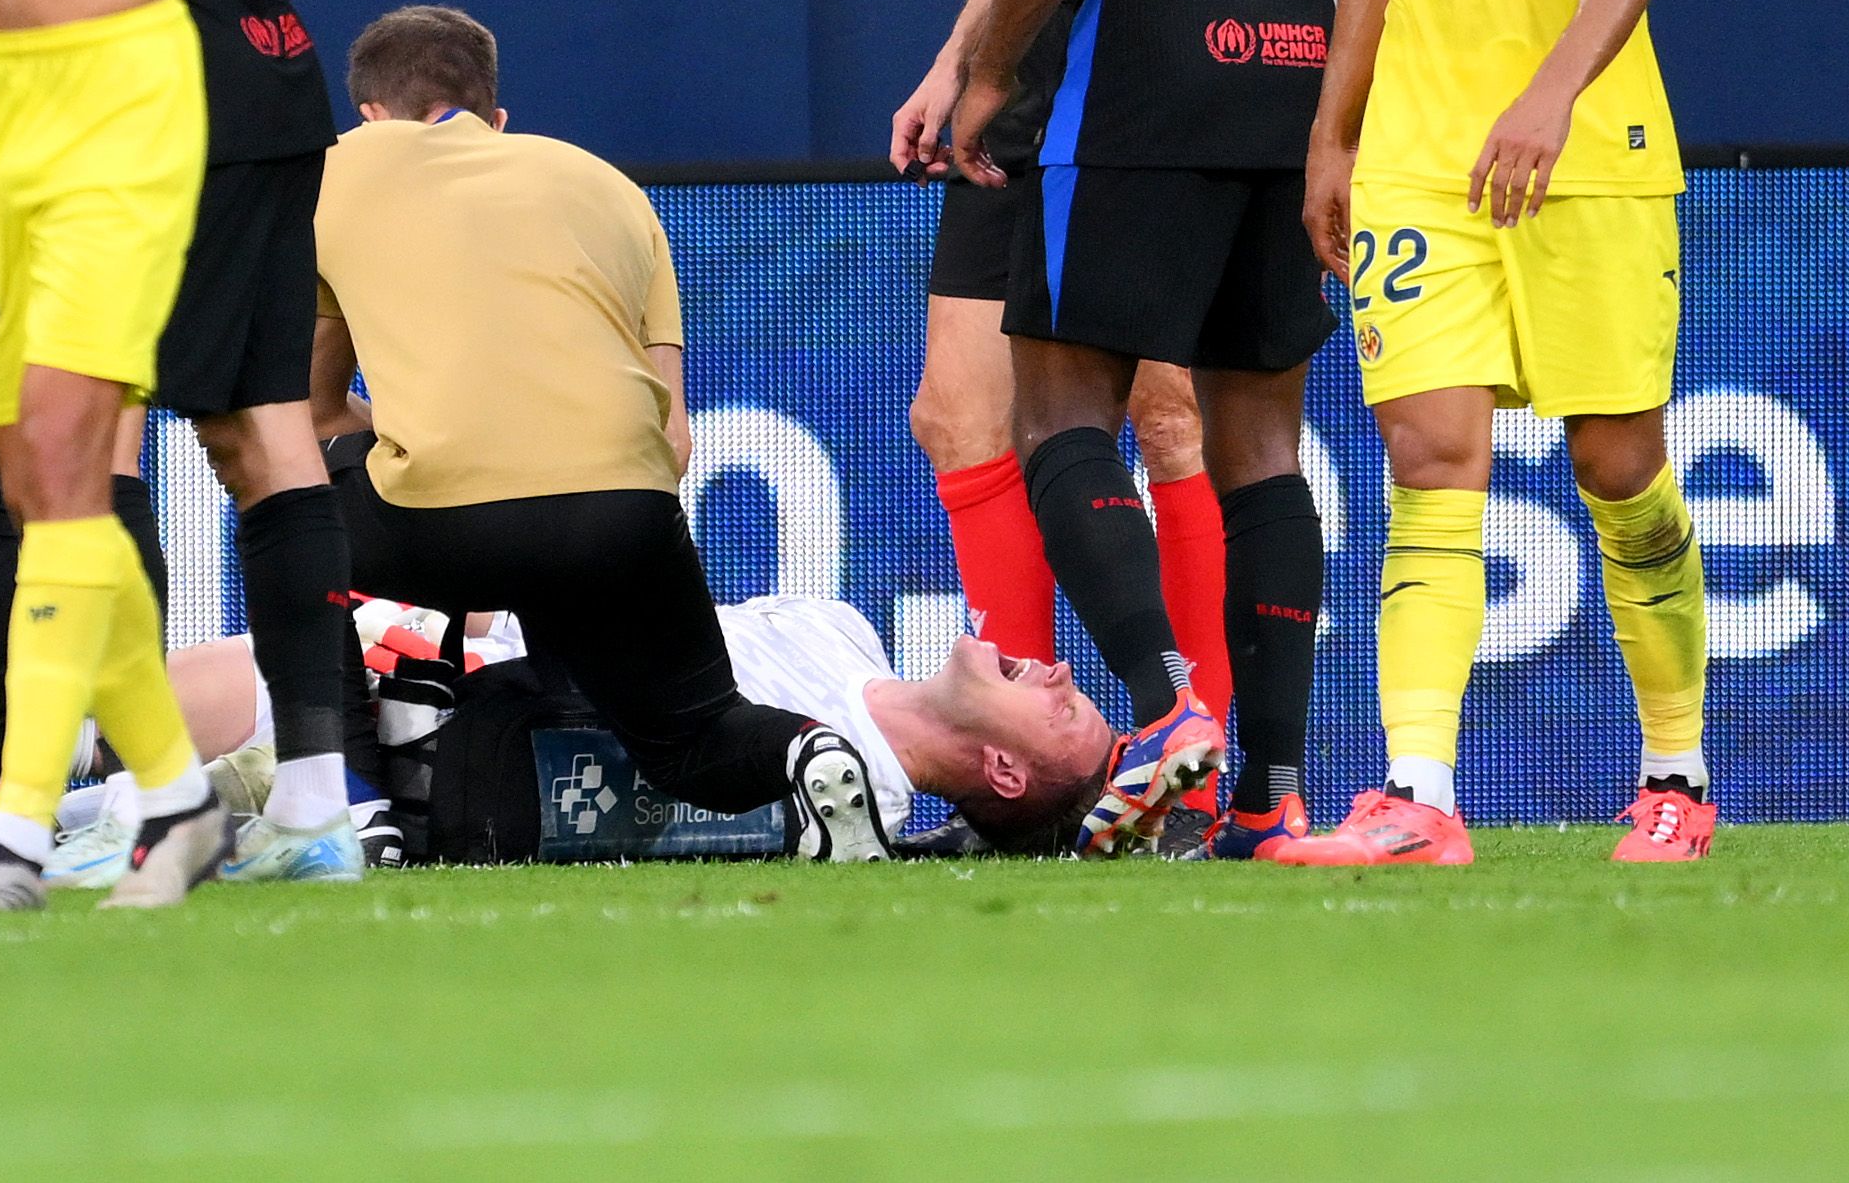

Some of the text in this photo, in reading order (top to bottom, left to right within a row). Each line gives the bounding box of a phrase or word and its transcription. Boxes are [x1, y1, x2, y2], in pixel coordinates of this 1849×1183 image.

[1258, 22, 1326, 42] UNHCR
[1260, 40, 1327, 60] ACNUR
[1353, 228, 1427, 312] 22
